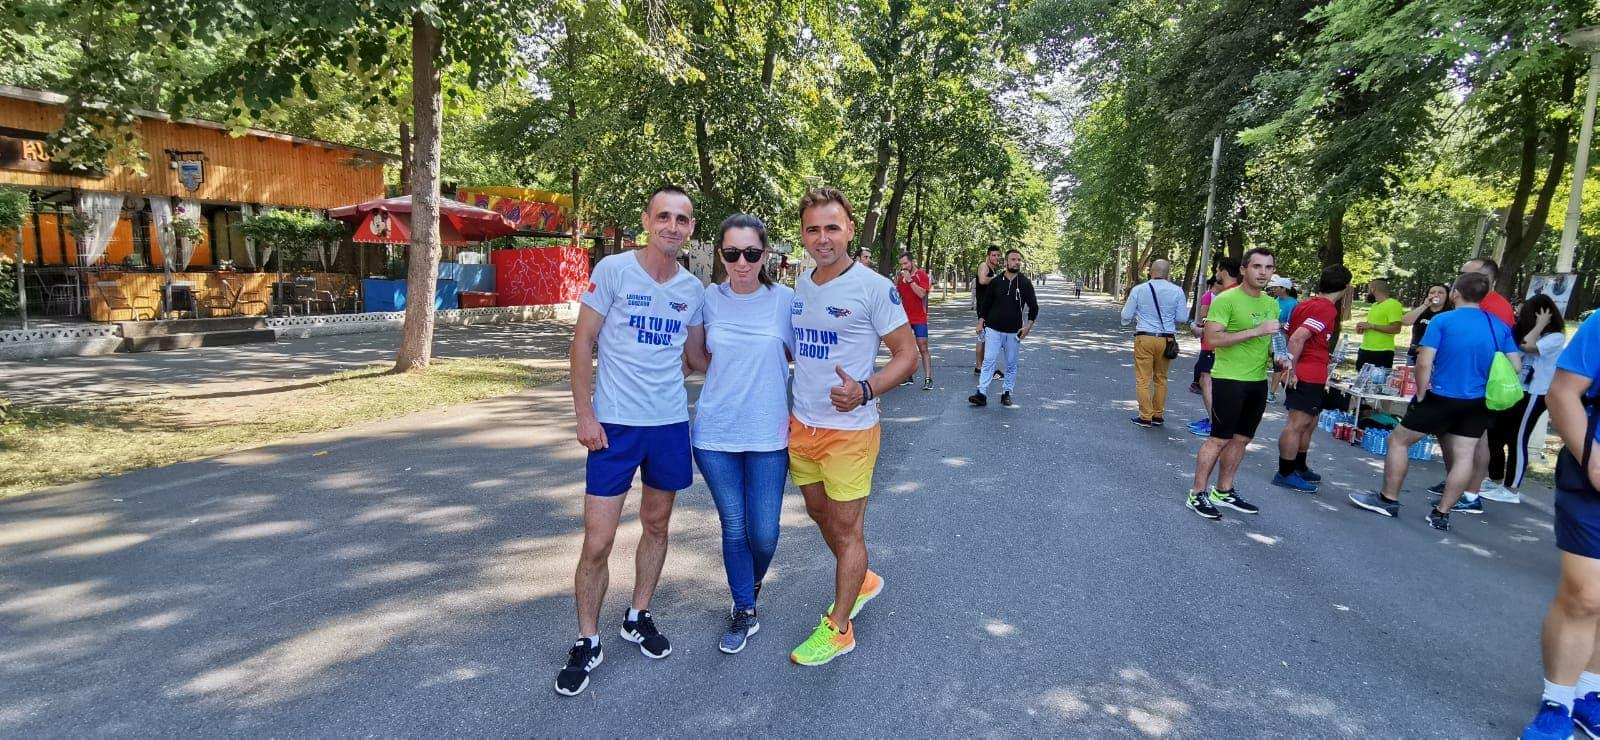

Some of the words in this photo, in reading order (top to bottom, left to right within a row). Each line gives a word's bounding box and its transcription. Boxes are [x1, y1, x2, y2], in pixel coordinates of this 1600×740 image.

[629, 315, 645, 329] FII
[649, 316, 663, 331] TU
[665, 319, 681, 333] UN
[637, 330, 673, 345] EROU!
[805, 328, 818, 343] TU
[820, 330, 838, 344] UN
[799, 343, 829, 359] EROU!
